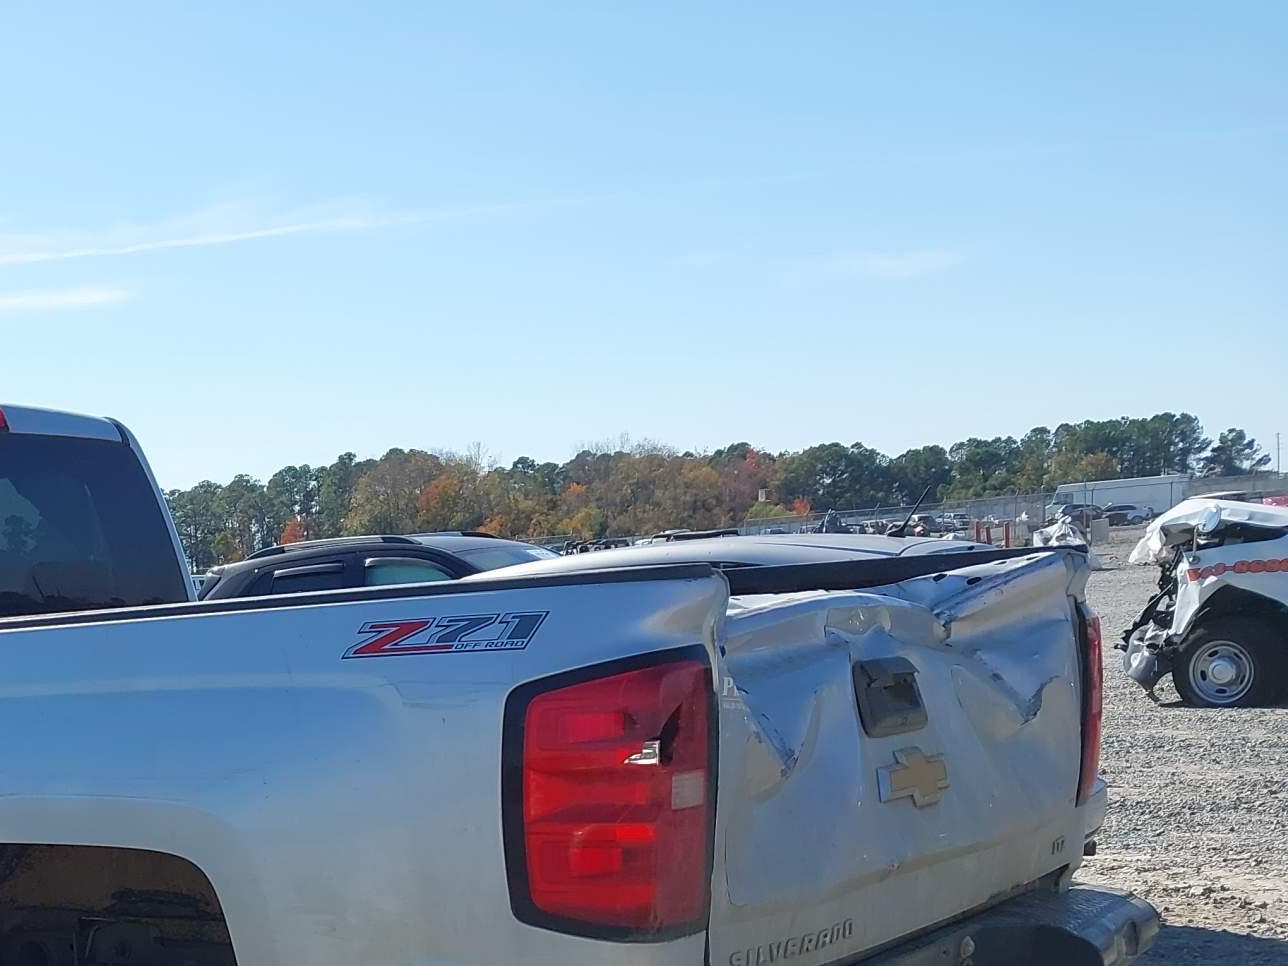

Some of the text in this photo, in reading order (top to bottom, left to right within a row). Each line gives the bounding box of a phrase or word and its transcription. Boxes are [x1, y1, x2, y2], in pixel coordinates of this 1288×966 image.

[342, 610, 551, 660] Z71
[454, 640, 525, 650] OFF ROAD
